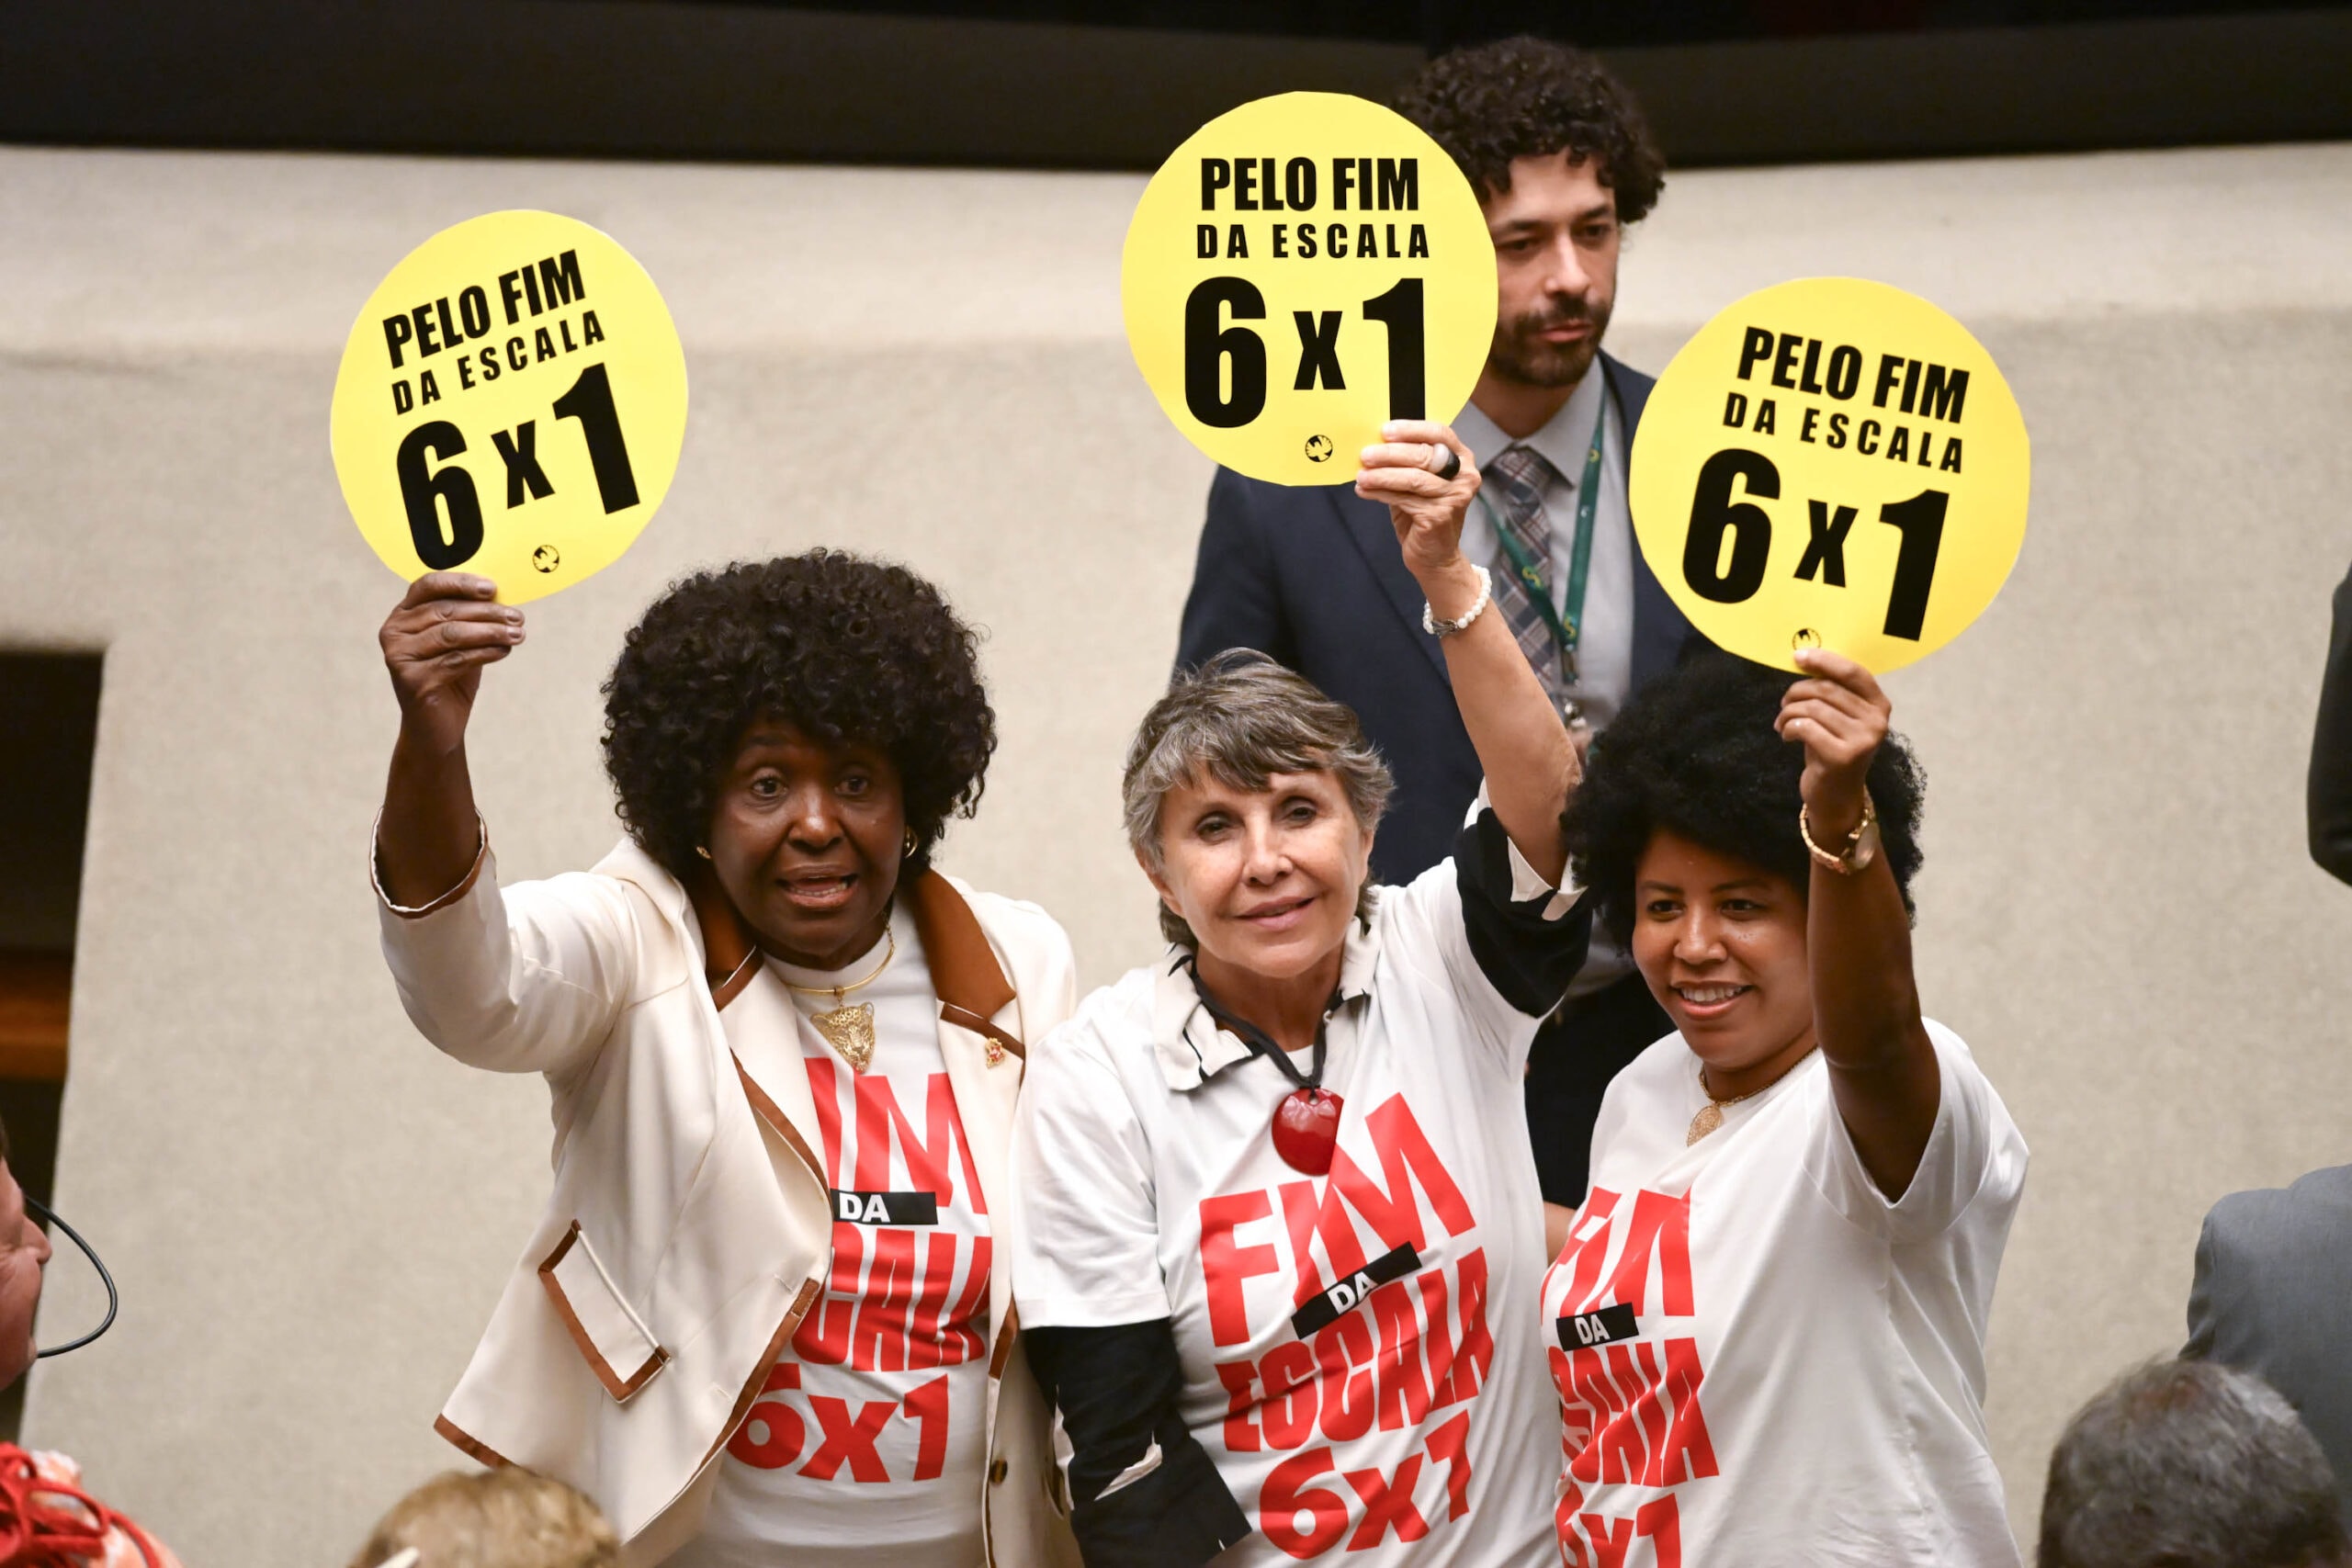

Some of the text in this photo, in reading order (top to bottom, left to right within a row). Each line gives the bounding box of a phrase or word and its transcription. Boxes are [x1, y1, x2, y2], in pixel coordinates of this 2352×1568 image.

[1201, 156, 1419, 211] PELO FIM
[1196, 223, 1430, 259] DA ESCALA
[382, 249, 585, 369] PELO FIM
[391, 310, 605, 415] DA ESCALA
[1737, 326, 1970, 423] PELO FIM
[1723, 392, 1962, 474] DA ESCALA
[804, 1056, 989, 1215] IM
[839, 1191, 890, 1223] DA
[1199, 1091, 1476, 1348] FIM
[1327, 1271, 1378, 1315] DA
[1575, 1314, 1610, 1345] DA
[1214, 1247, 1495, 1452] ESCALA
[726, 1363, 949, 1483] 6x1
[1259, 1409, 1472, 1560] 6x1
